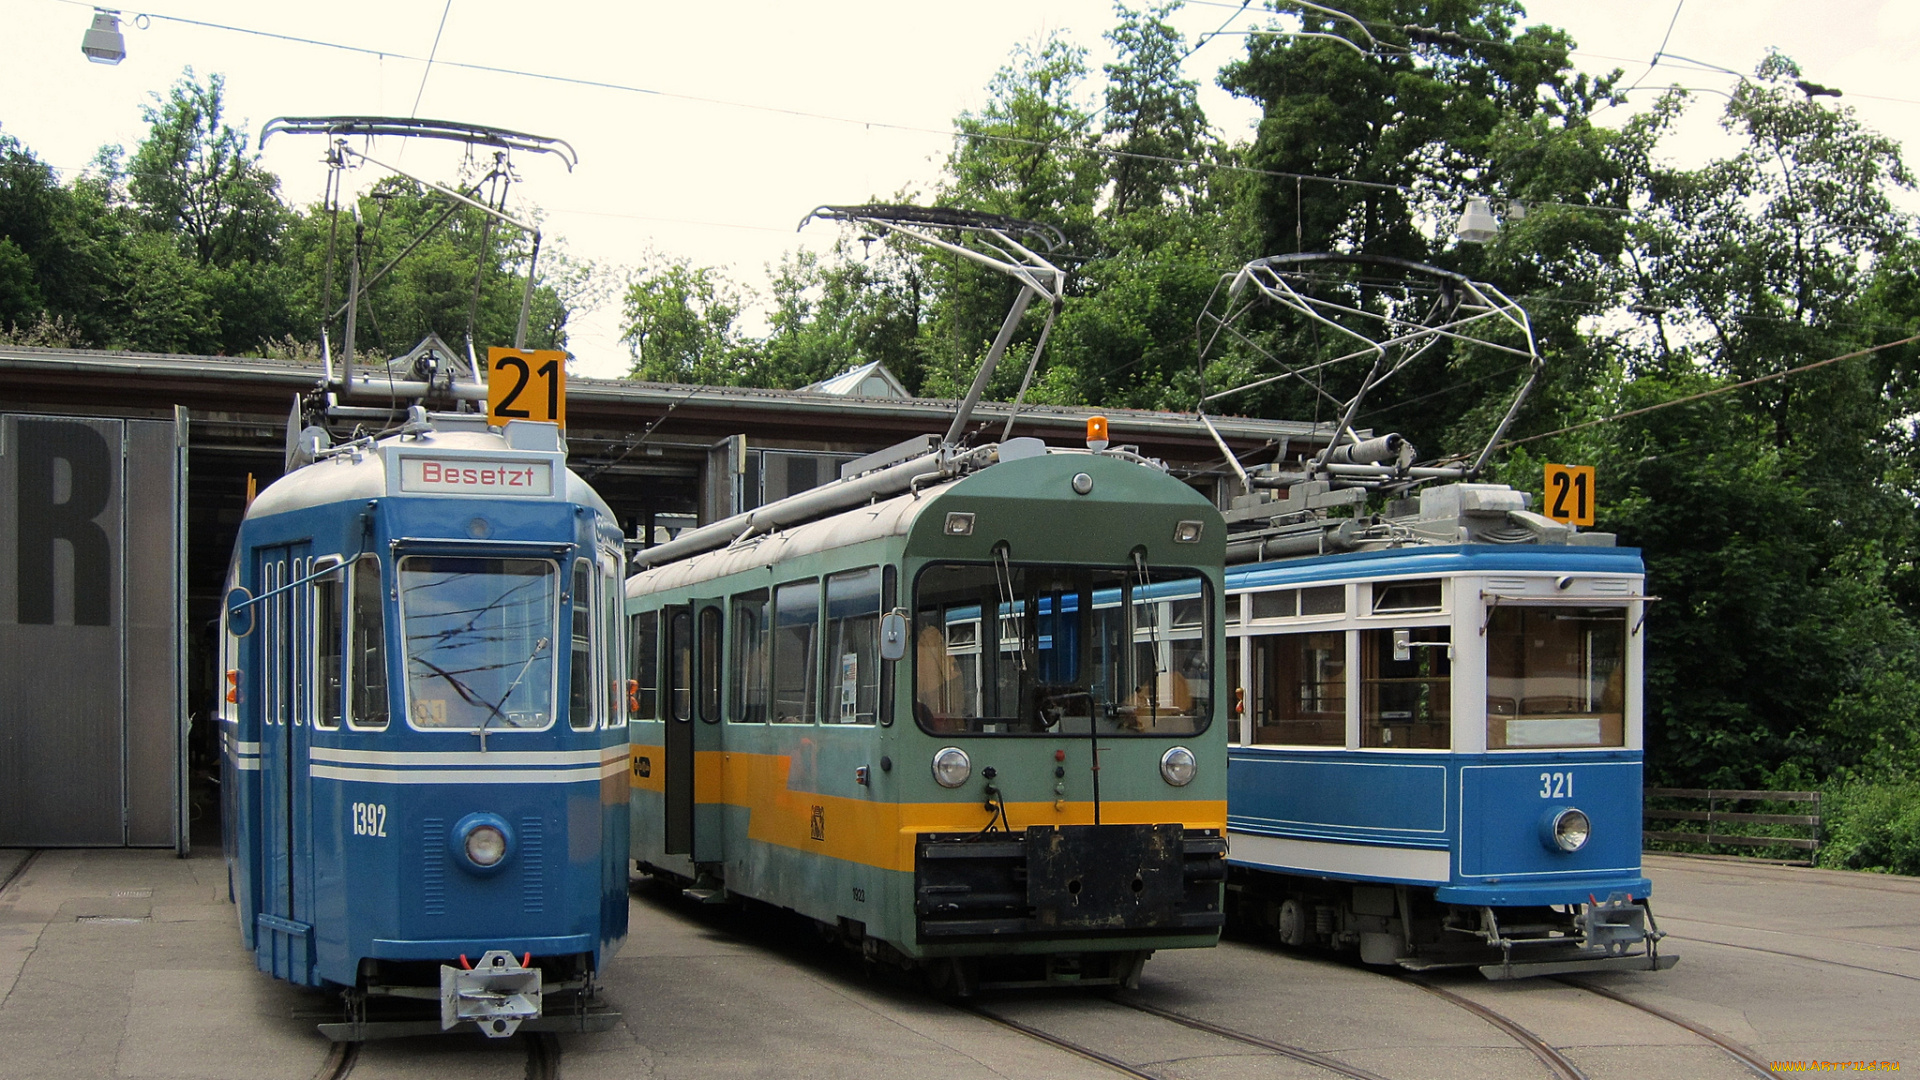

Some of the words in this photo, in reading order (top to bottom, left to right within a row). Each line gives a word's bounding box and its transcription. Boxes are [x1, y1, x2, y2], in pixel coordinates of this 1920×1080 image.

[494, 356, 559, 420] 21
[422, 462, 534, 487] Besetzt
[1552, 471, 1587, 519] 21
[17, 420, 111, 626] R
[1540, 772, 1573, 798] 321
[352, 802, 387, 837] 1392
